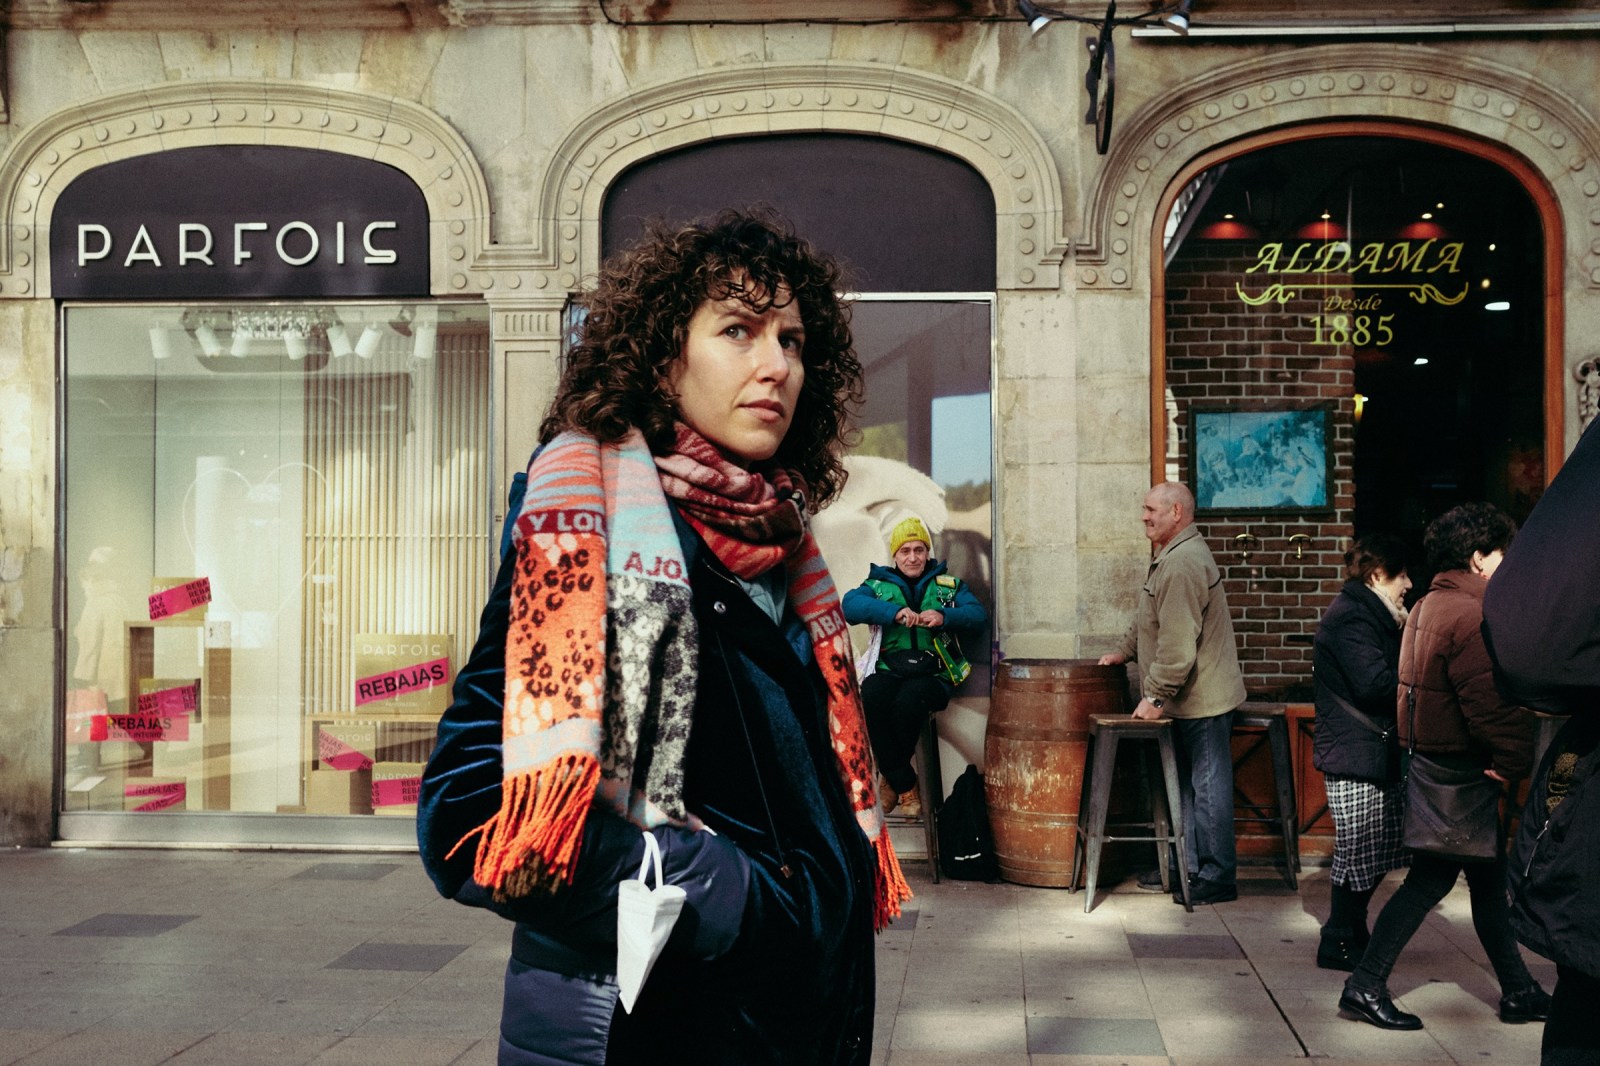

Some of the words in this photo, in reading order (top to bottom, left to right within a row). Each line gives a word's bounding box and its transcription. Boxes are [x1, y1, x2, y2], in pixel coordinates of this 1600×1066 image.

[77, 221, 398, 267] PARFOIS
[1245, 237, 1465, 275] ALDAMA
[1324, 292, 1383, 312] Desde
[1310, 313, 1395, 347] 1885
[362, 643, 441, 657] PARFOIS
[358, 664, 445, 699] REBAJAS
[107, 717, 172, 730] REBAJAS
